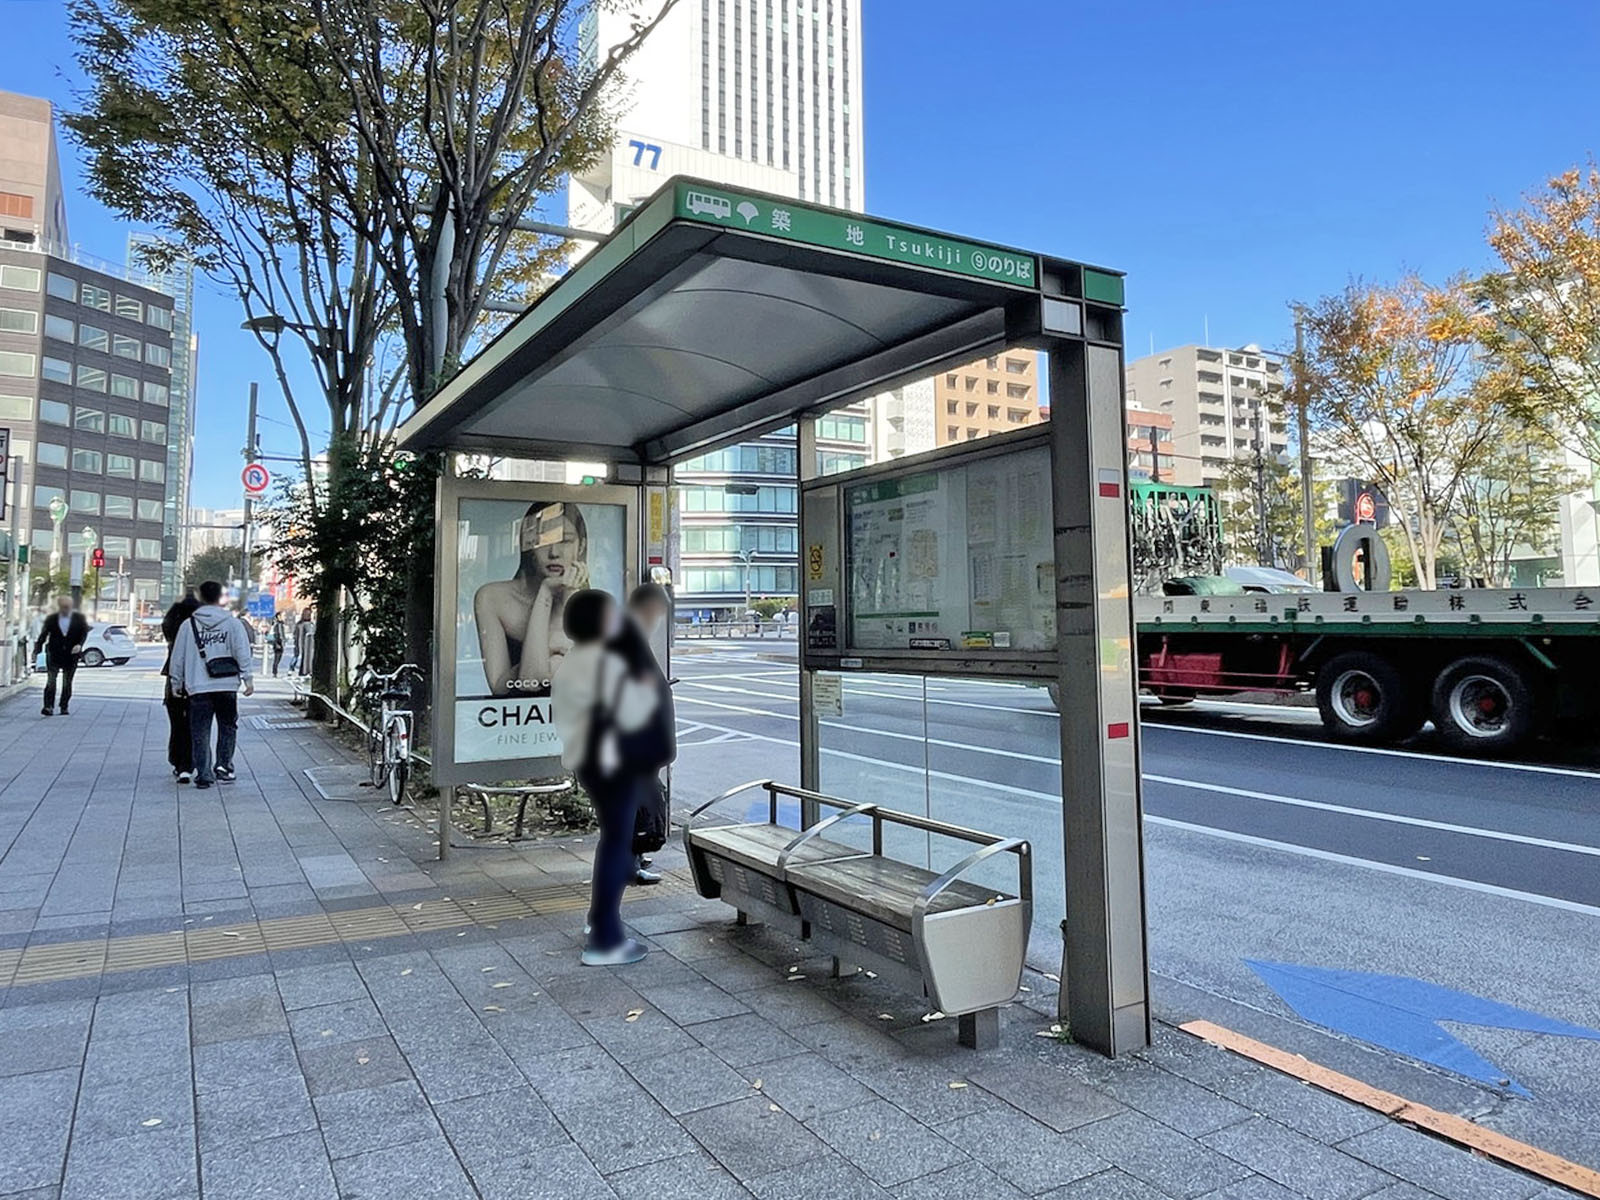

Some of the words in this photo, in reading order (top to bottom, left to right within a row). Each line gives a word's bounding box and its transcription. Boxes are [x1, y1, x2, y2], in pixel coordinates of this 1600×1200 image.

[629, 139, 662, 171] 77
[771, 208, 864, 246] 築地
[886, 235, 960, 265] Tsukiji
[506, 680, 539, 688] COCO
[497, 733, 528, 745] FINE
